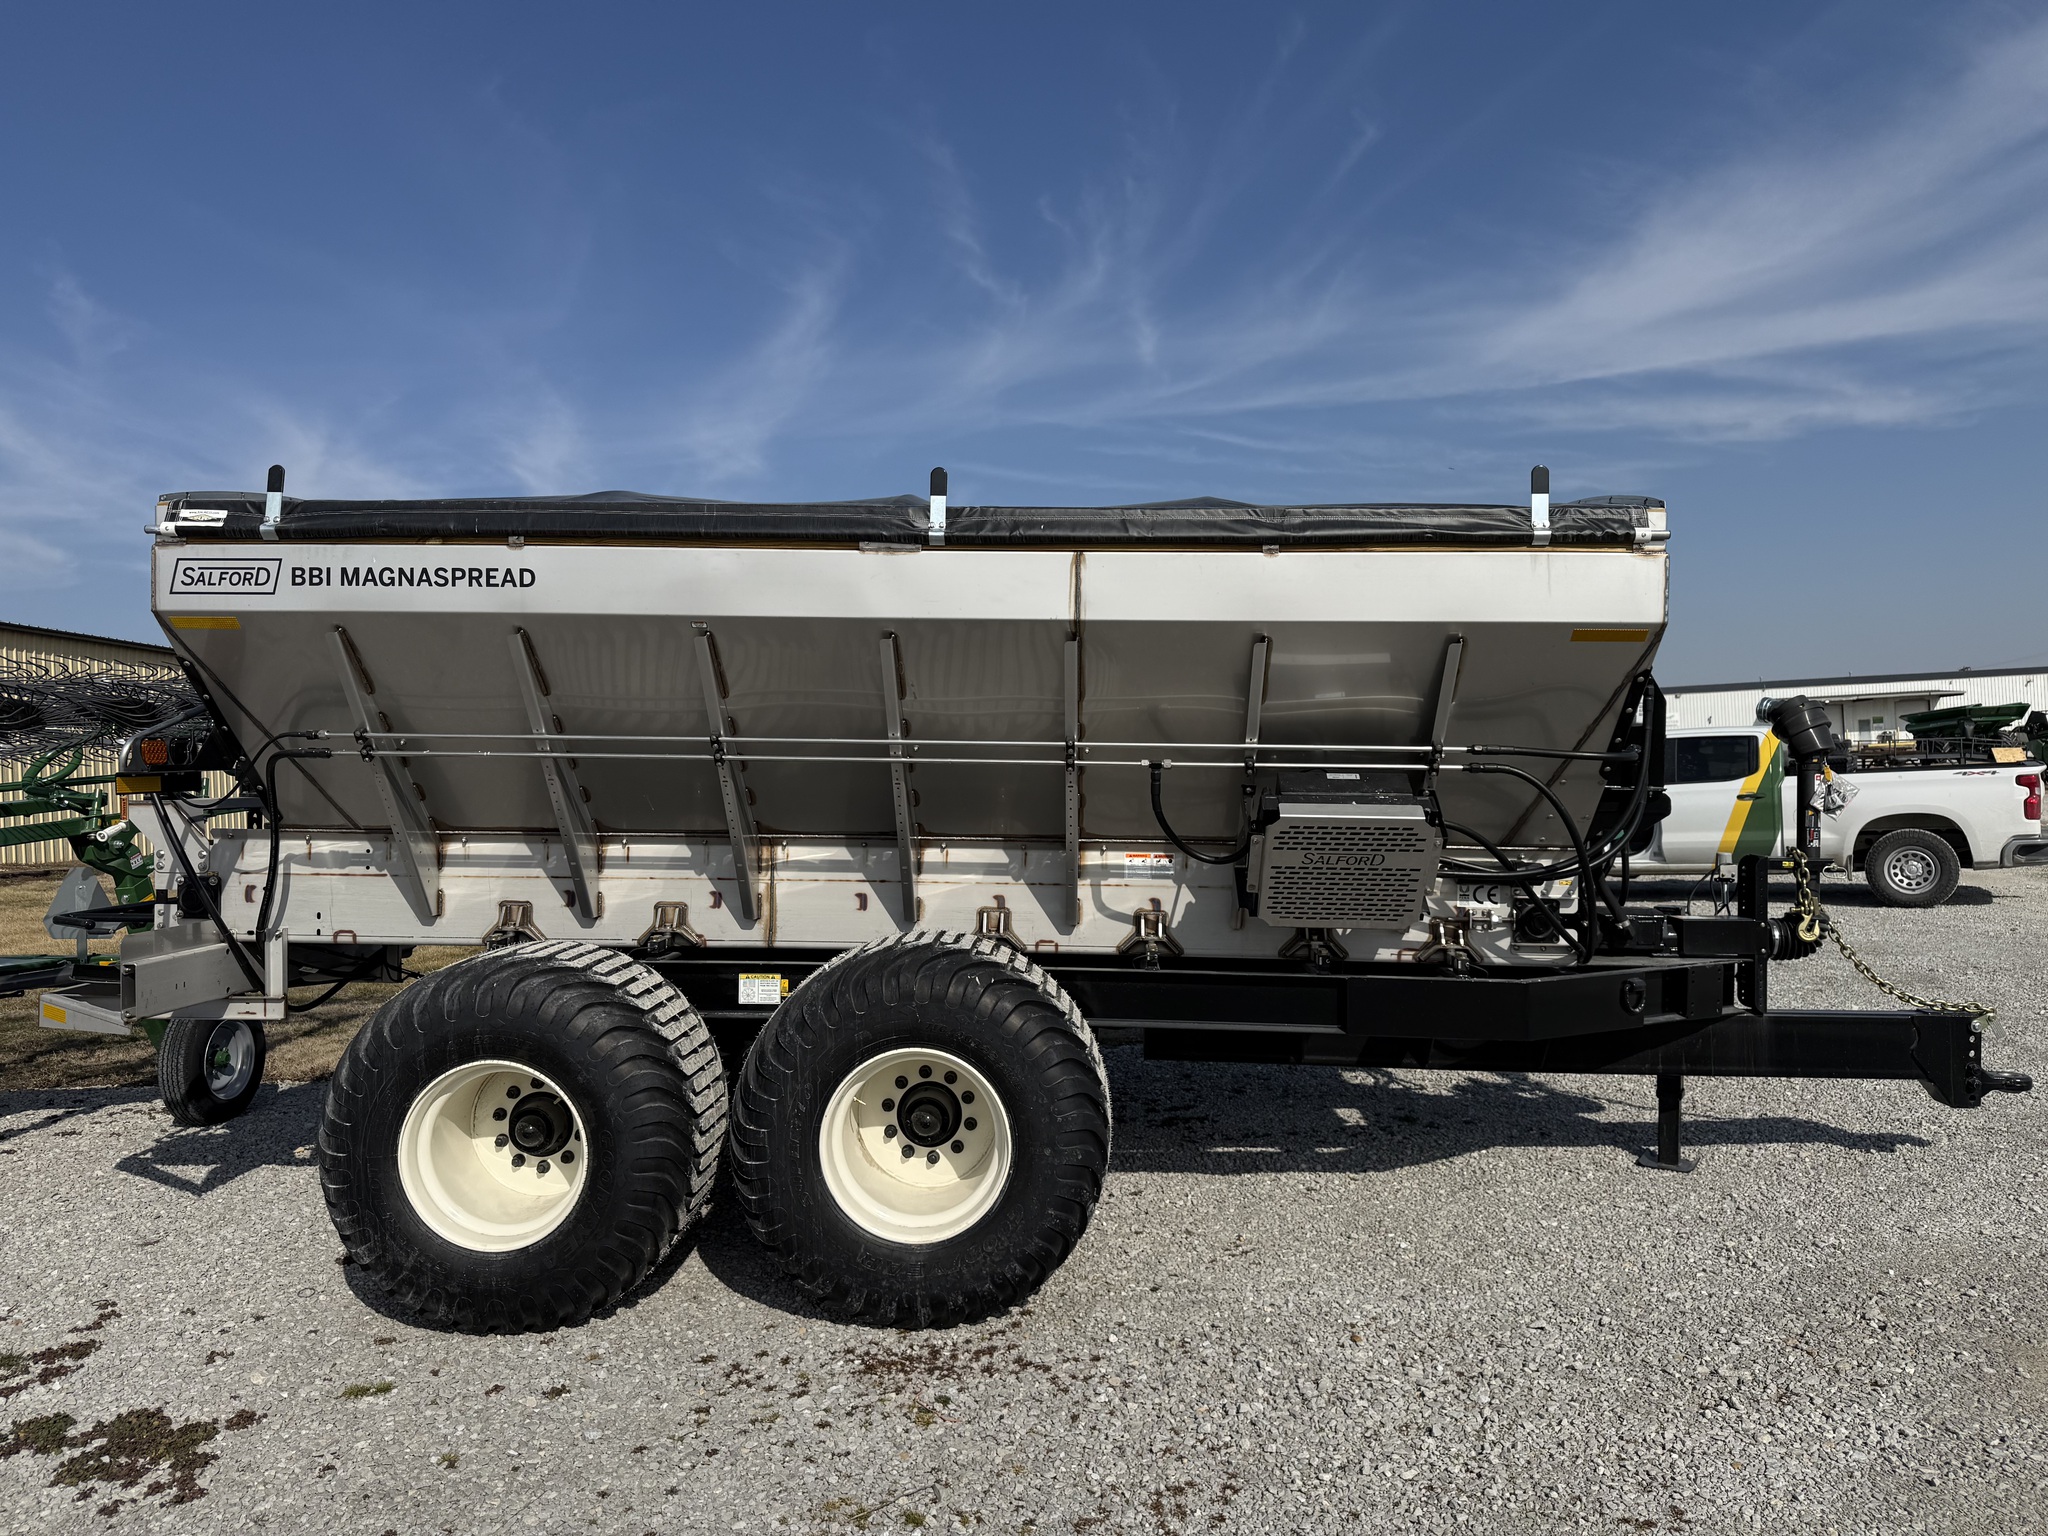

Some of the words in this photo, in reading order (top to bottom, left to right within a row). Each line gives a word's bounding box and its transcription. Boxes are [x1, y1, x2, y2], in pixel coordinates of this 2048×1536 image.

[180, 566, 271, 587] SALFORD
[291, 566, 330, 587] BBI
[340, 566, 536, 588] MAGNASPREAD
[1301, 852, 1385, 866] SALFORD
[1473, 885, 1498, 905] CE
